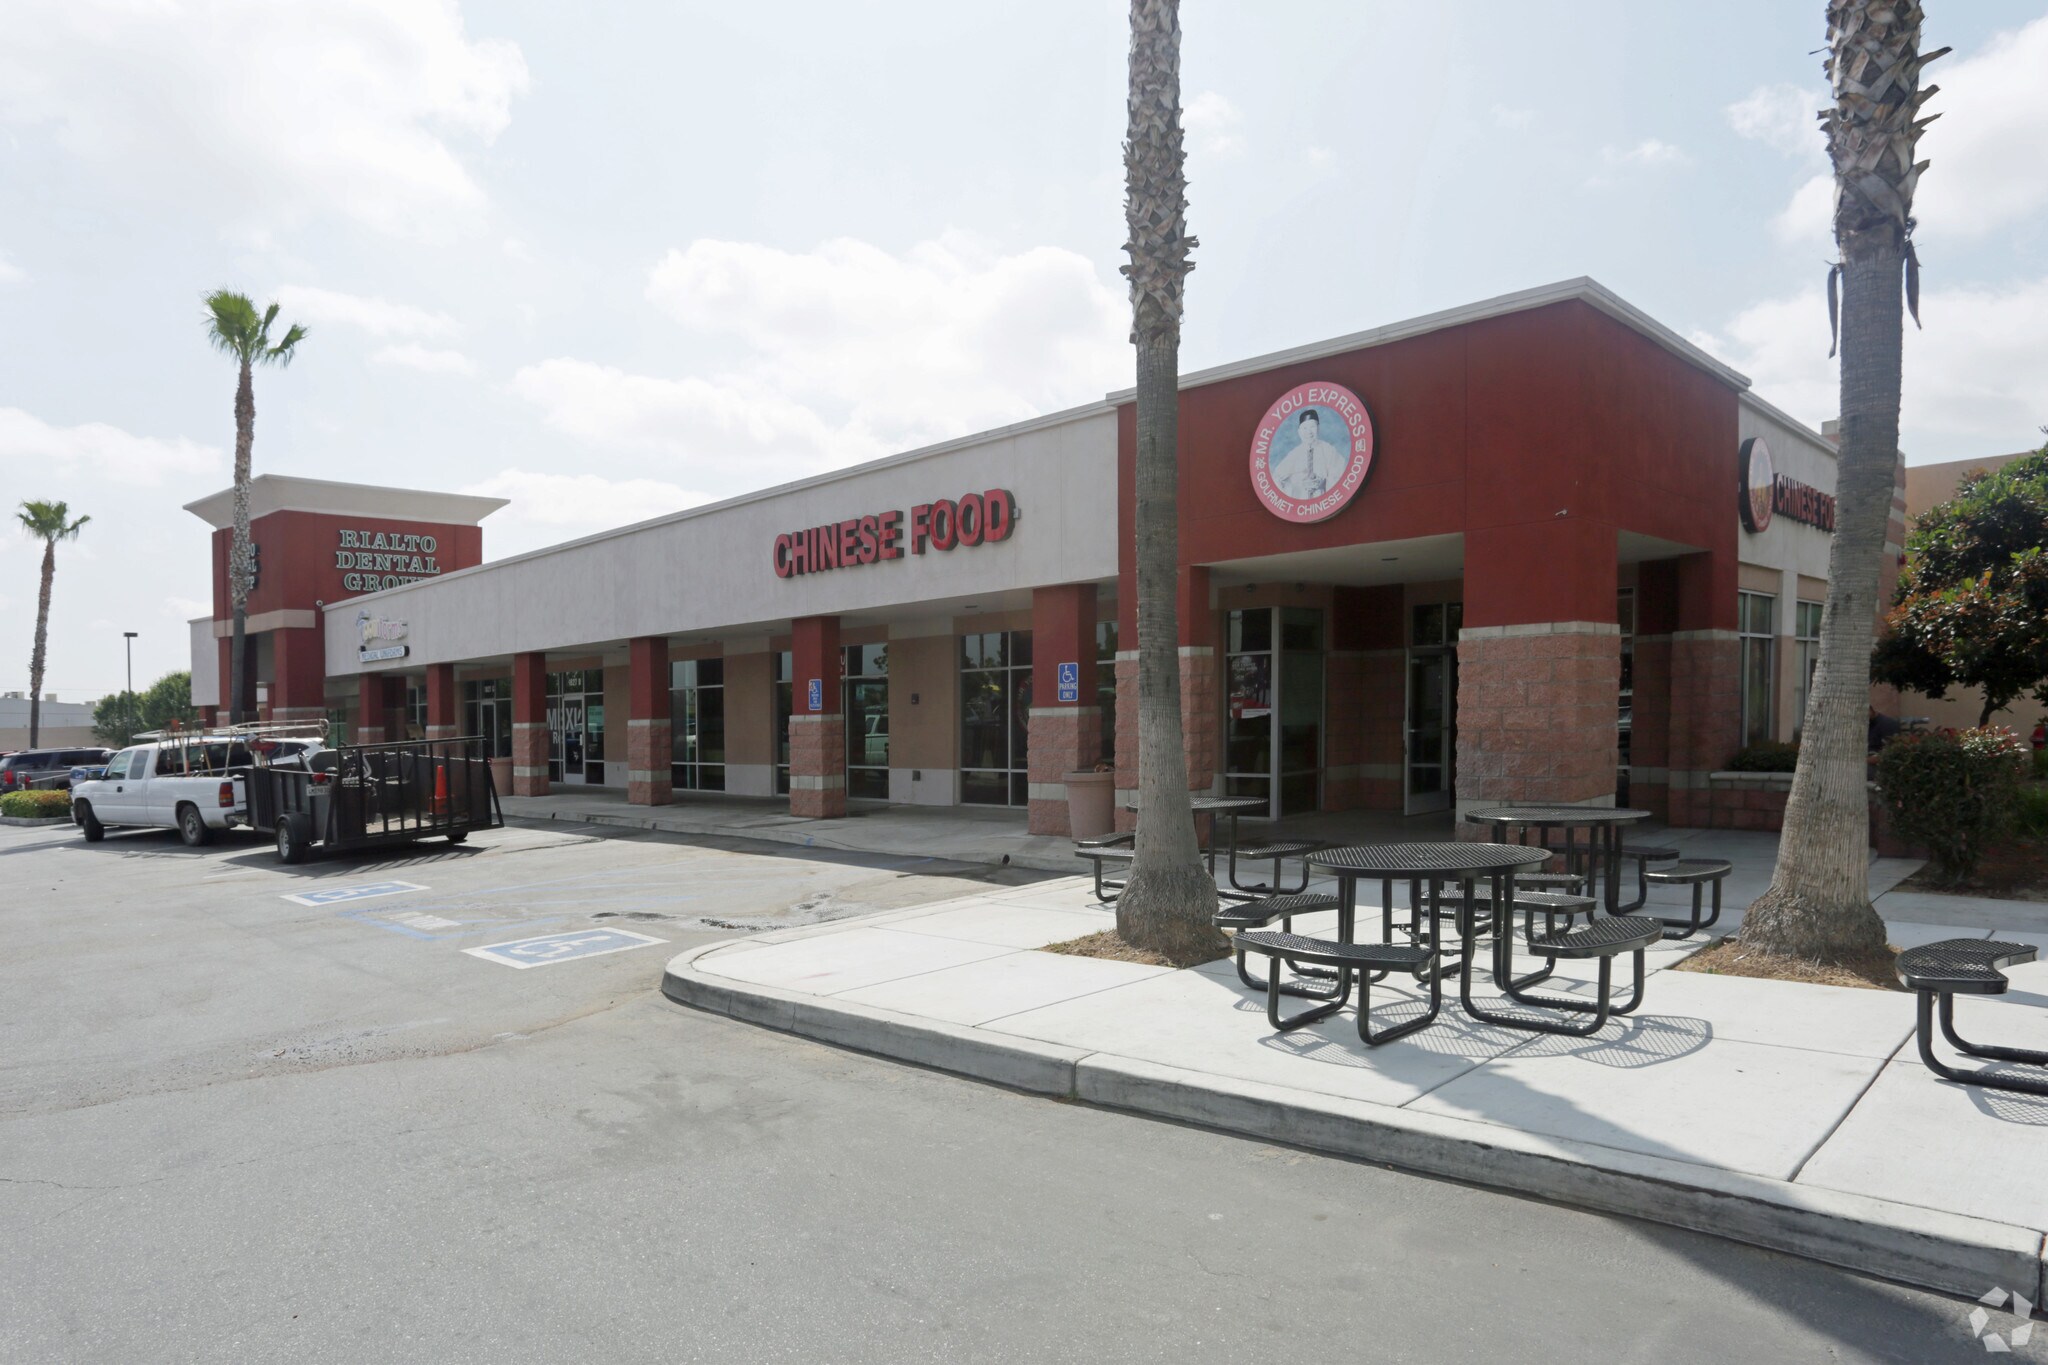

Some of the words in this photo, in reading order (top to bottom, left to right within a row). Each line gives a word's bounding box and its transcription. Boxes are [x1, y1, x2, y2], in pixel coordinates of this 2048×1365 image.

[1256, 426, 1275, 454] MR.
[1271, 392, 1303, 421] YOU
[1308, 388, 1366, 438] EXPRESS
[1256, 471, 1294, 514] GOURMET
[1296, 489, 1343, 517] CHINESE
[1342, 454, 1364, 491] FOOD
[1777, 472, 1819, 526] CHINESE
[340, 529, 437, 553] RIALTO
[773, 510, 904, 578] CHINESE
[911, 488, 1016, 555] FOOD
[335, 551, 440, 574] DENTAL
[343, 572, 426, 592] GRO
[1060, 682, 1077, 690] PARKING
